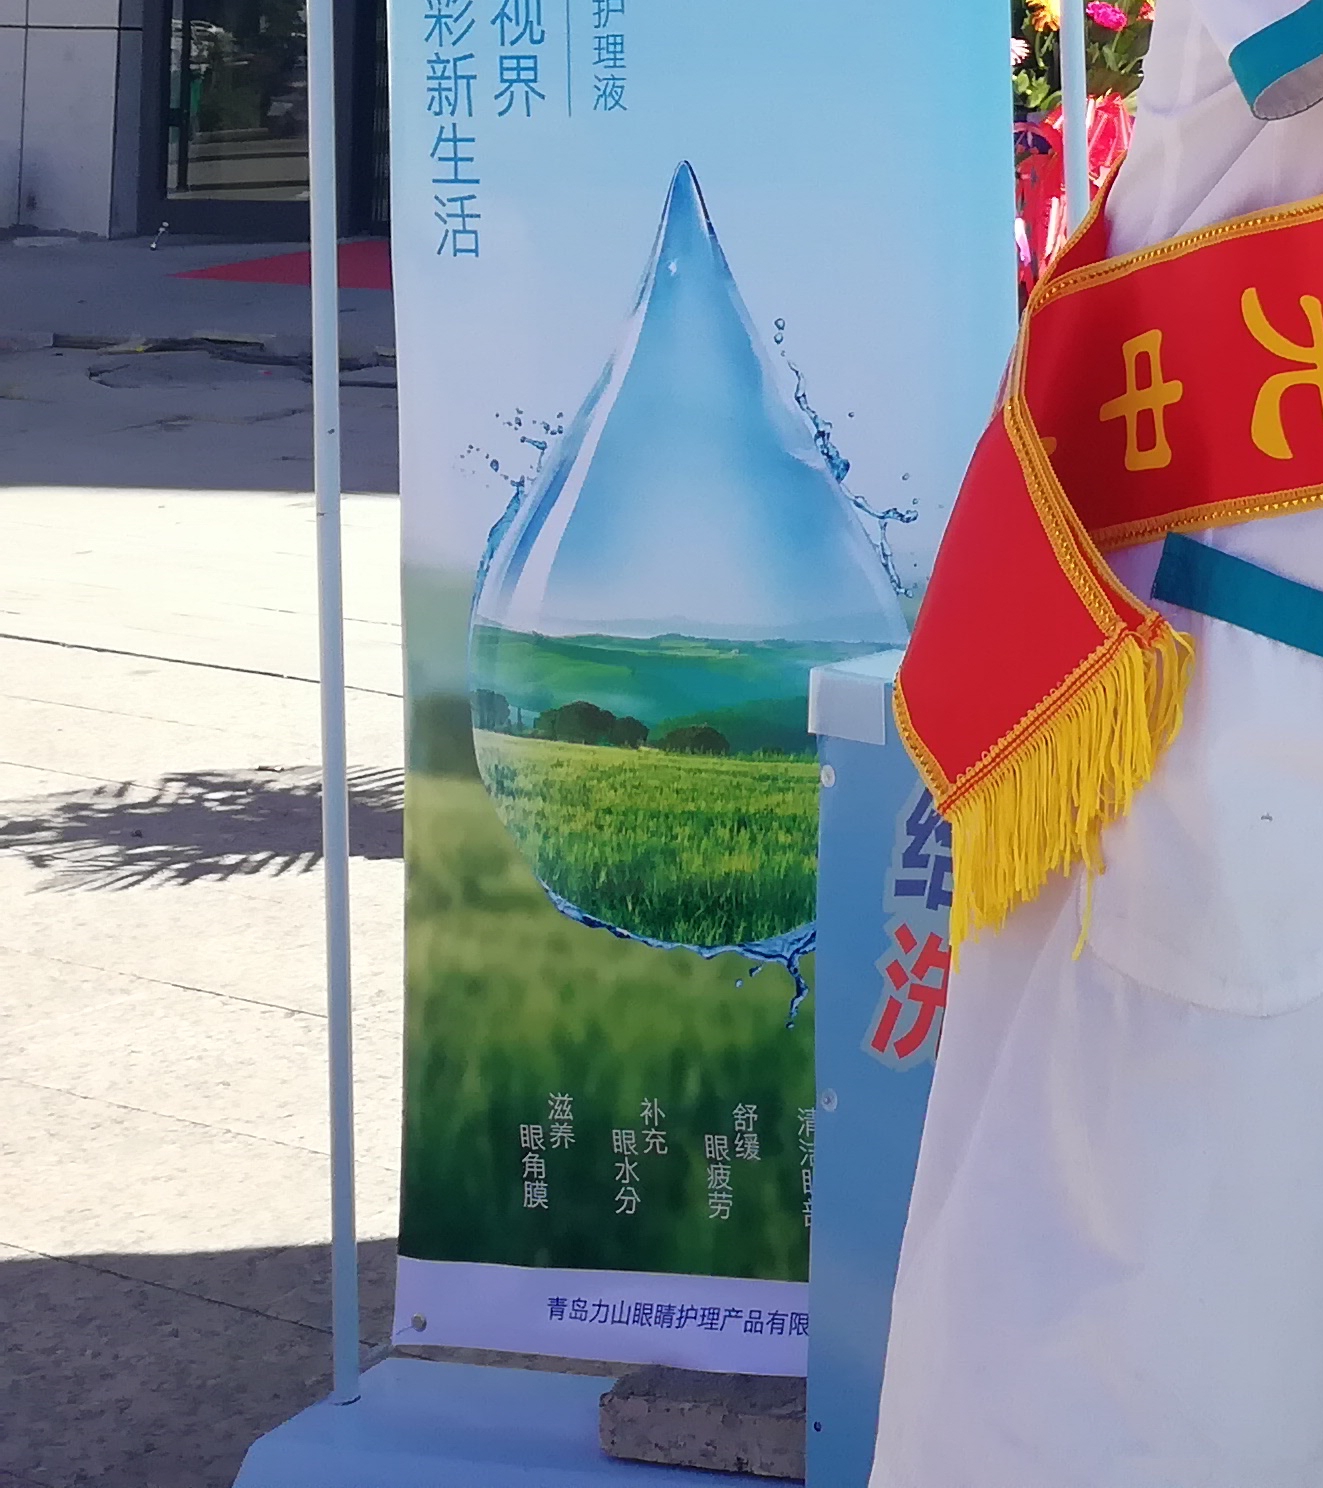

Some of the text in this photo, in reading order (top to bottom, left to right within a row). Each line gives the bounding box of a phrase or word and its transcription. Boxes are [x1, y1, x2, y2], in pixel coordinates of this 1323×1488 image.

[547, 1091, 576, 1150] 滋养
[639, 1097, 668, 1155] 补充
[732, 1102, 762, 1162] 舒缓
[519, 1123, 549, 1210] 眼角膜
[612, 1128, 642, 1215] 眼水分
[703, 1133, 734, 1220] 眼疲劳
